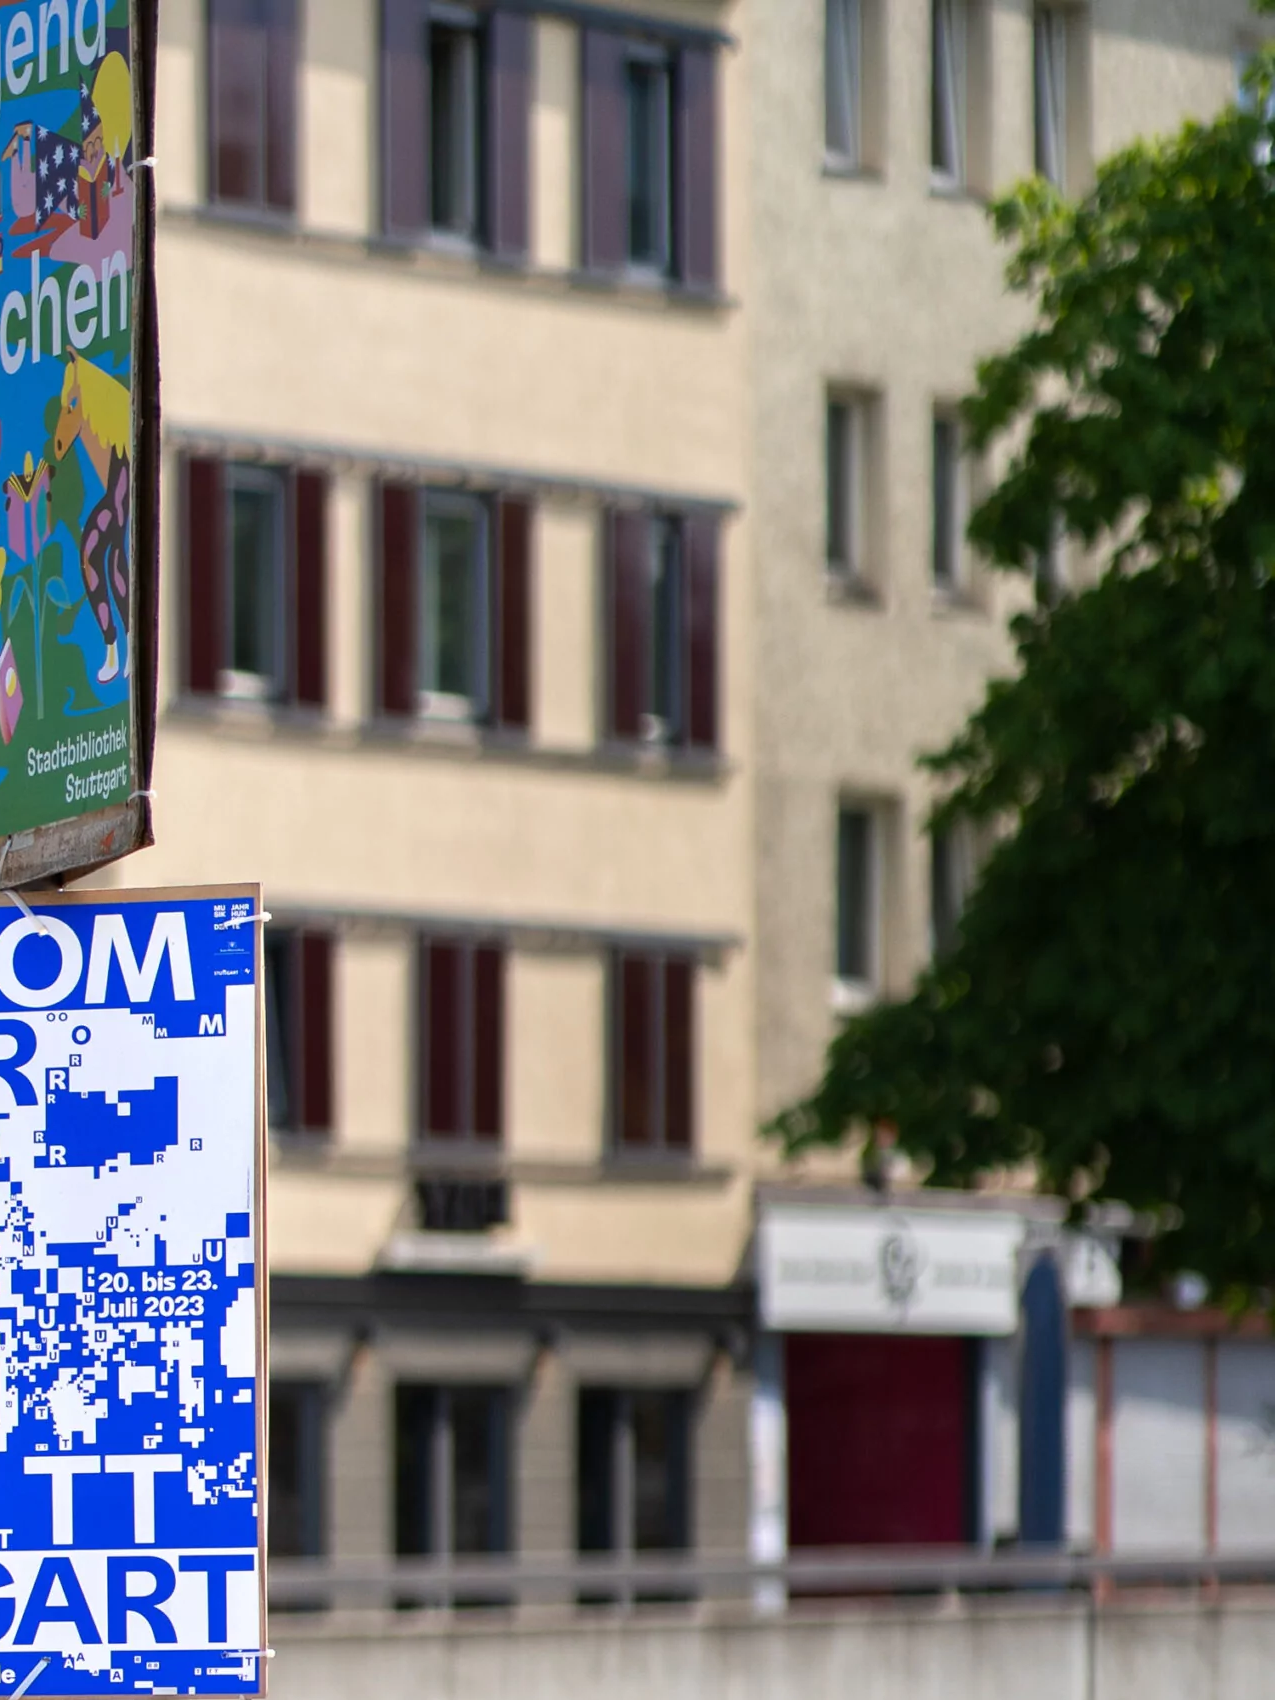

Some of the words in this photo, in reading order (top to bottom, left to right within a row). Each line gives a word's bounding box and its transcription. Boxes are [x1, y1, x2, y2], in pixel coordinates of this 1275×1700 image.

[27, 719, 128, 777] Stadtbibliothek
[65, 763, 127, 803] Stuttgart
[72, 1025, 91, 1045] O
[198, 1013, 224, 1035] M
[49, 1070, 67, 1090] R
[49, 1145, 67, 1166] R
[205, 1241, 223, 1262] U
[98, 1272, 135, 1293] 20.
[142, 1270, 175, 1292] bis
[181, 1269, 218, 1291] 23.
[98, 1296, 138, 1318] Juli
[144, 1295, 205, 1317] 2023
[24, 1455, 182, 1545] TT
